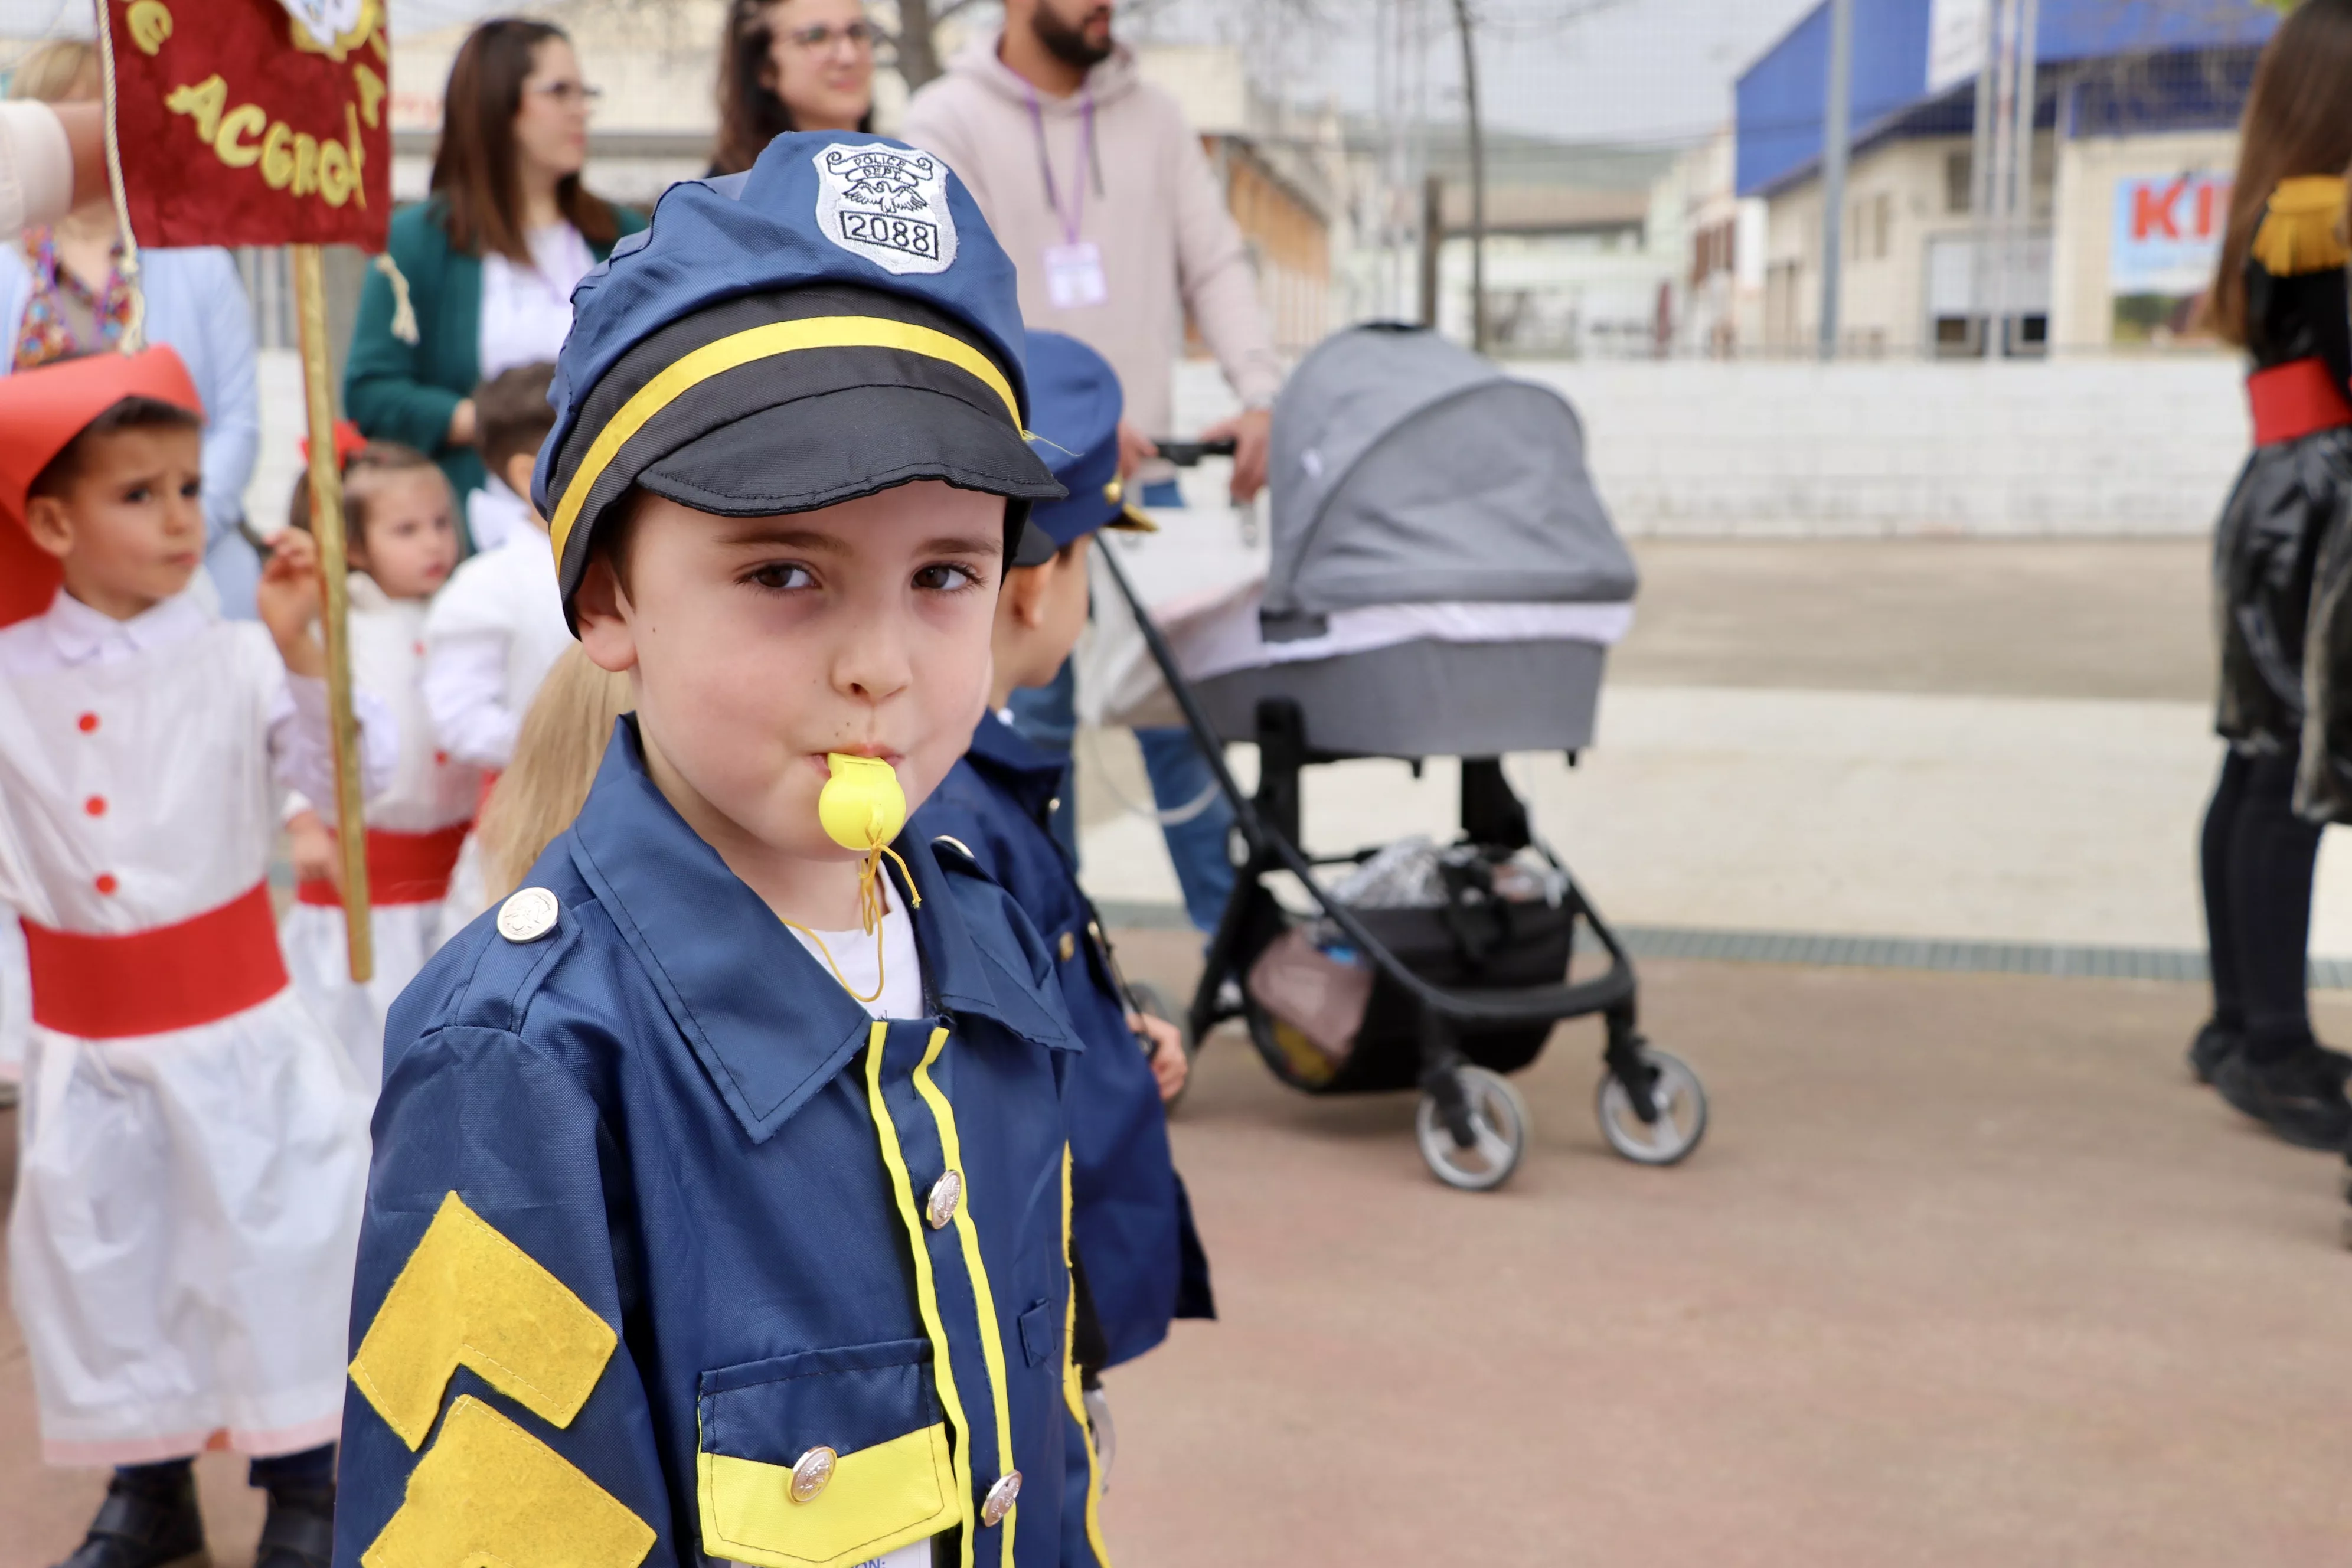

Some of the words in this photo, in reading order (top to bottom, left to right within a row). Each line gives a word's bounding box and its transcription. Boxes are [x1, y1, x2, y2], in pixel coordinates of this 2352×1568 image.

[854, 156, 906, 167] POLICE
[2131, 177, 2229, 240] KI
[848, 215, 929, 252] 2088
